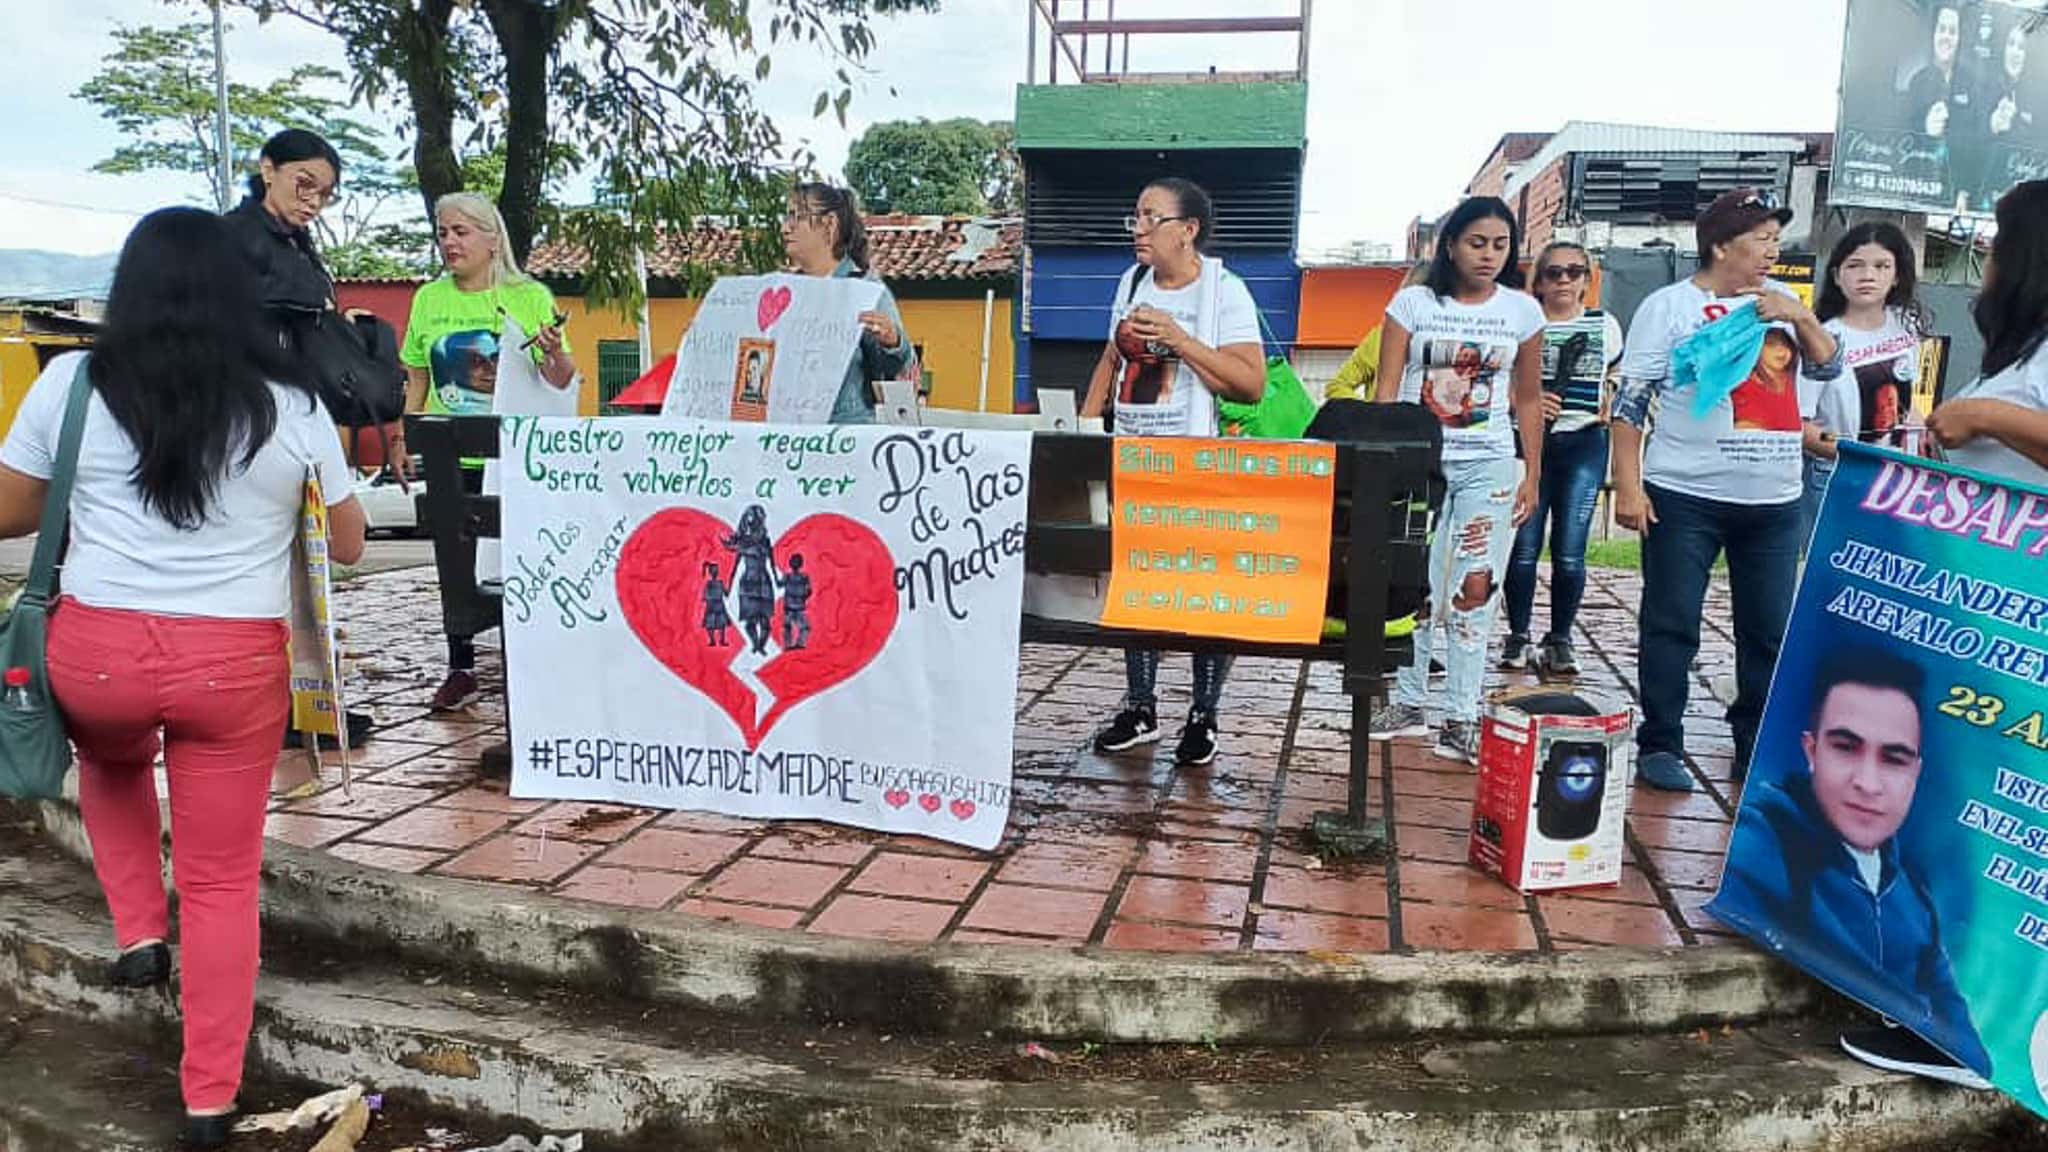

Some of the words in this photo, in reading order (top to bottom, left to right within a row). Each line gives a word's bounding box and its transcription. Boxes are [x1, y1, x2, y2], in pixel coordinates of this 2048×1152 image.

[647, 424, 735, 471] mejor
[758, 426, 857, 471] regalo
[1119, 444, 1175, 475] Sin
[546, 458, 603, 493] será
[623, 456, 733, 498] volverlos
[755, 477, 778, 499] a
[797, 475, 856, 498] ver
[911, 485, 950, 543] de
[956, 463, 1024, 515] las
[1123, 500, 1280, 534] tenemos
[1860, 458, 2048, 556] DESAP
[894, 516, 1026, 621] Madres
[1128, 549, 1218, 573] nada
[1232, 551, 1300, 577] que
[1123, 585, 1291, 617] celebrar
[1826, 586, 1985, 660] AREVALO
[1938, 685, 2006, 728] 23
[1984, 852, 2014, 888] EL
